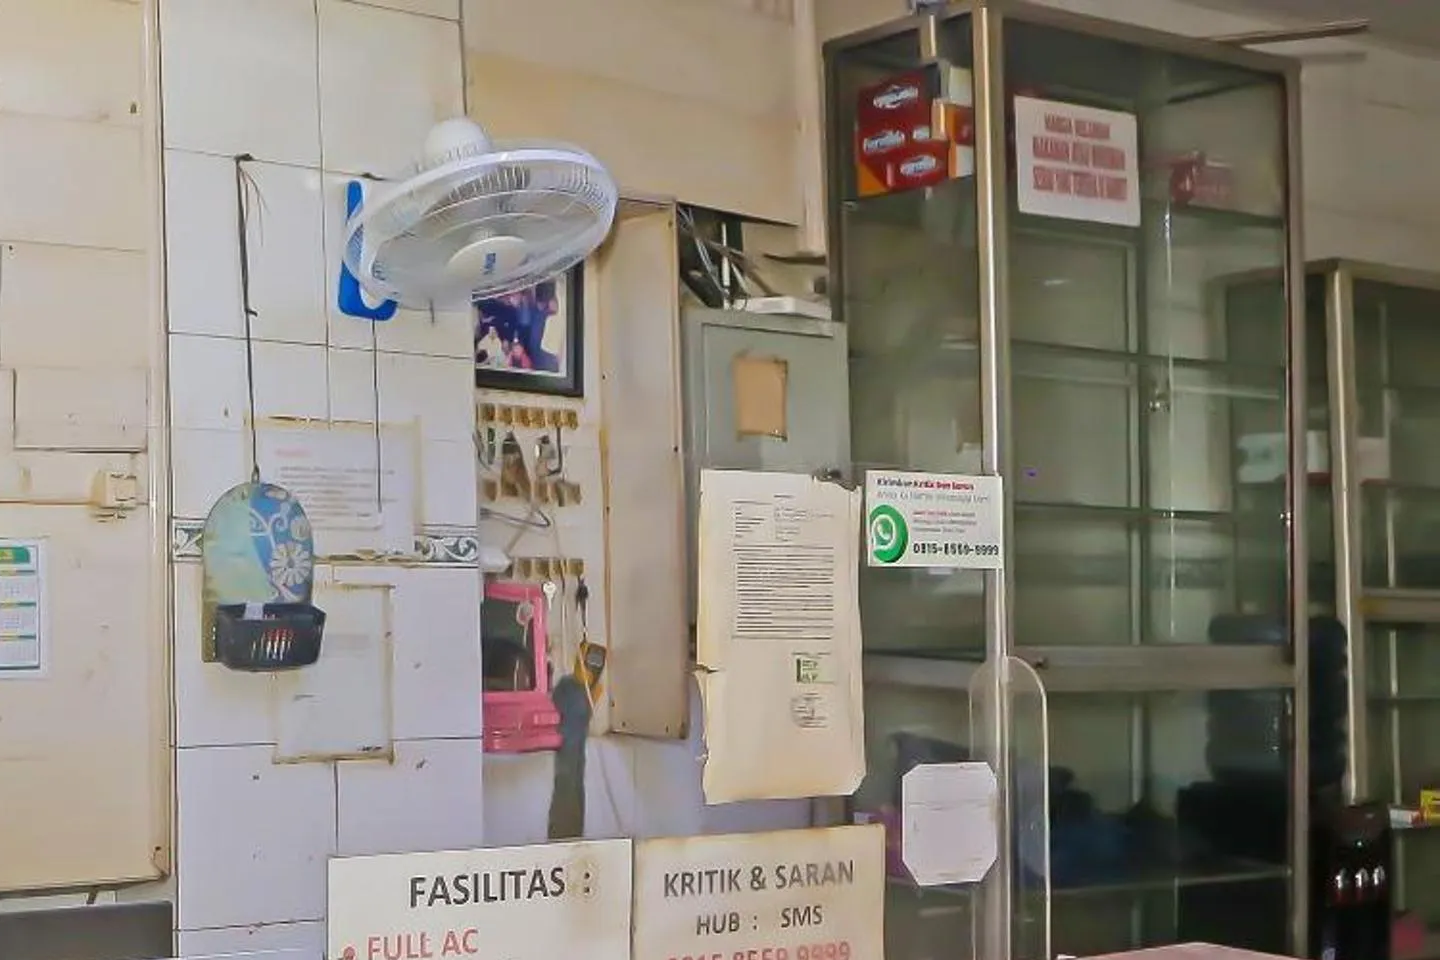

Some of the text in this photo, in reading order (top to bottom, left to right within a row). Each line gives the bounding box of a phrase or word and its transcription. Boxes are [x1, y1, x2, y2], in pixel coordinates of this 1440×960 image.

[410, 867, 566, 908] FASILITAS
[664, 860, 854, 898] KRITIK & SARAN
[696, 912, 740, 936] HUB
[781, 904, 823, 929] SMS
[442, 928, 479, 957] AC
